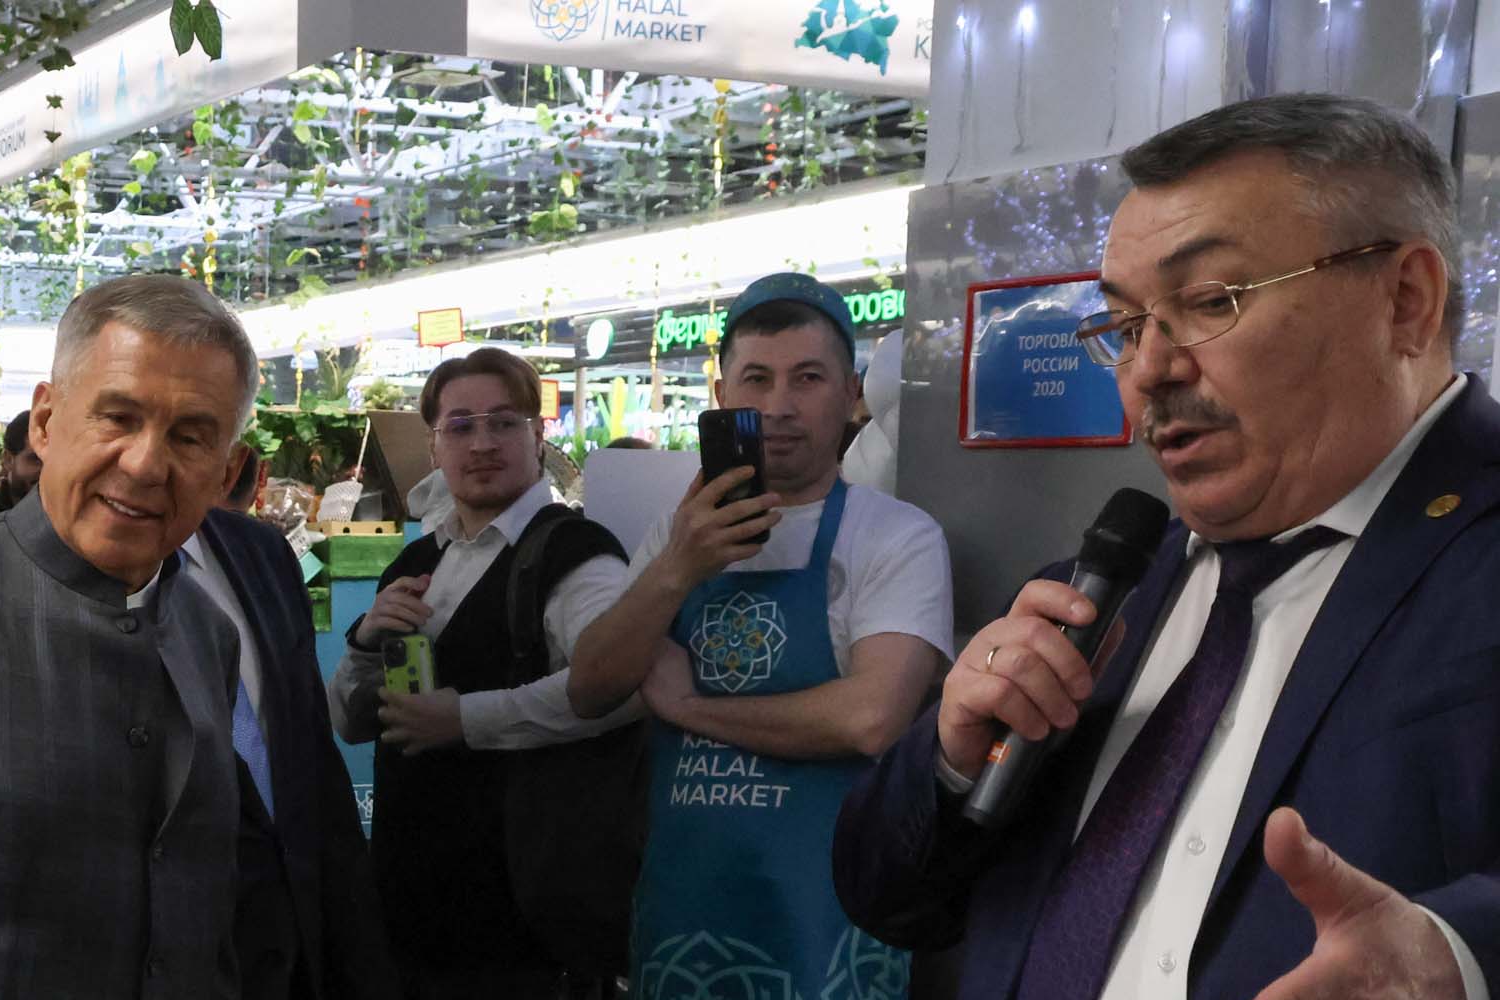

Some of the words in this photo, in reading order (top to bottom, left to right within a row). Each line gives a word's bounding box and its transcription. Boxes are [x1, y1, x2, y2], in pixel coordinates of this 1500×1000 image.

[613, 19, 707, 42] MARKET
[1018, 332, 1086, 351] ТОРГОВЛ
[1023, 356, 1080, 373] РОССИИ
[1033, 380, 1066, 397] 2020
[676, 754, 765, 778] HALAL
[670, 783, 791, 808] MARKET
